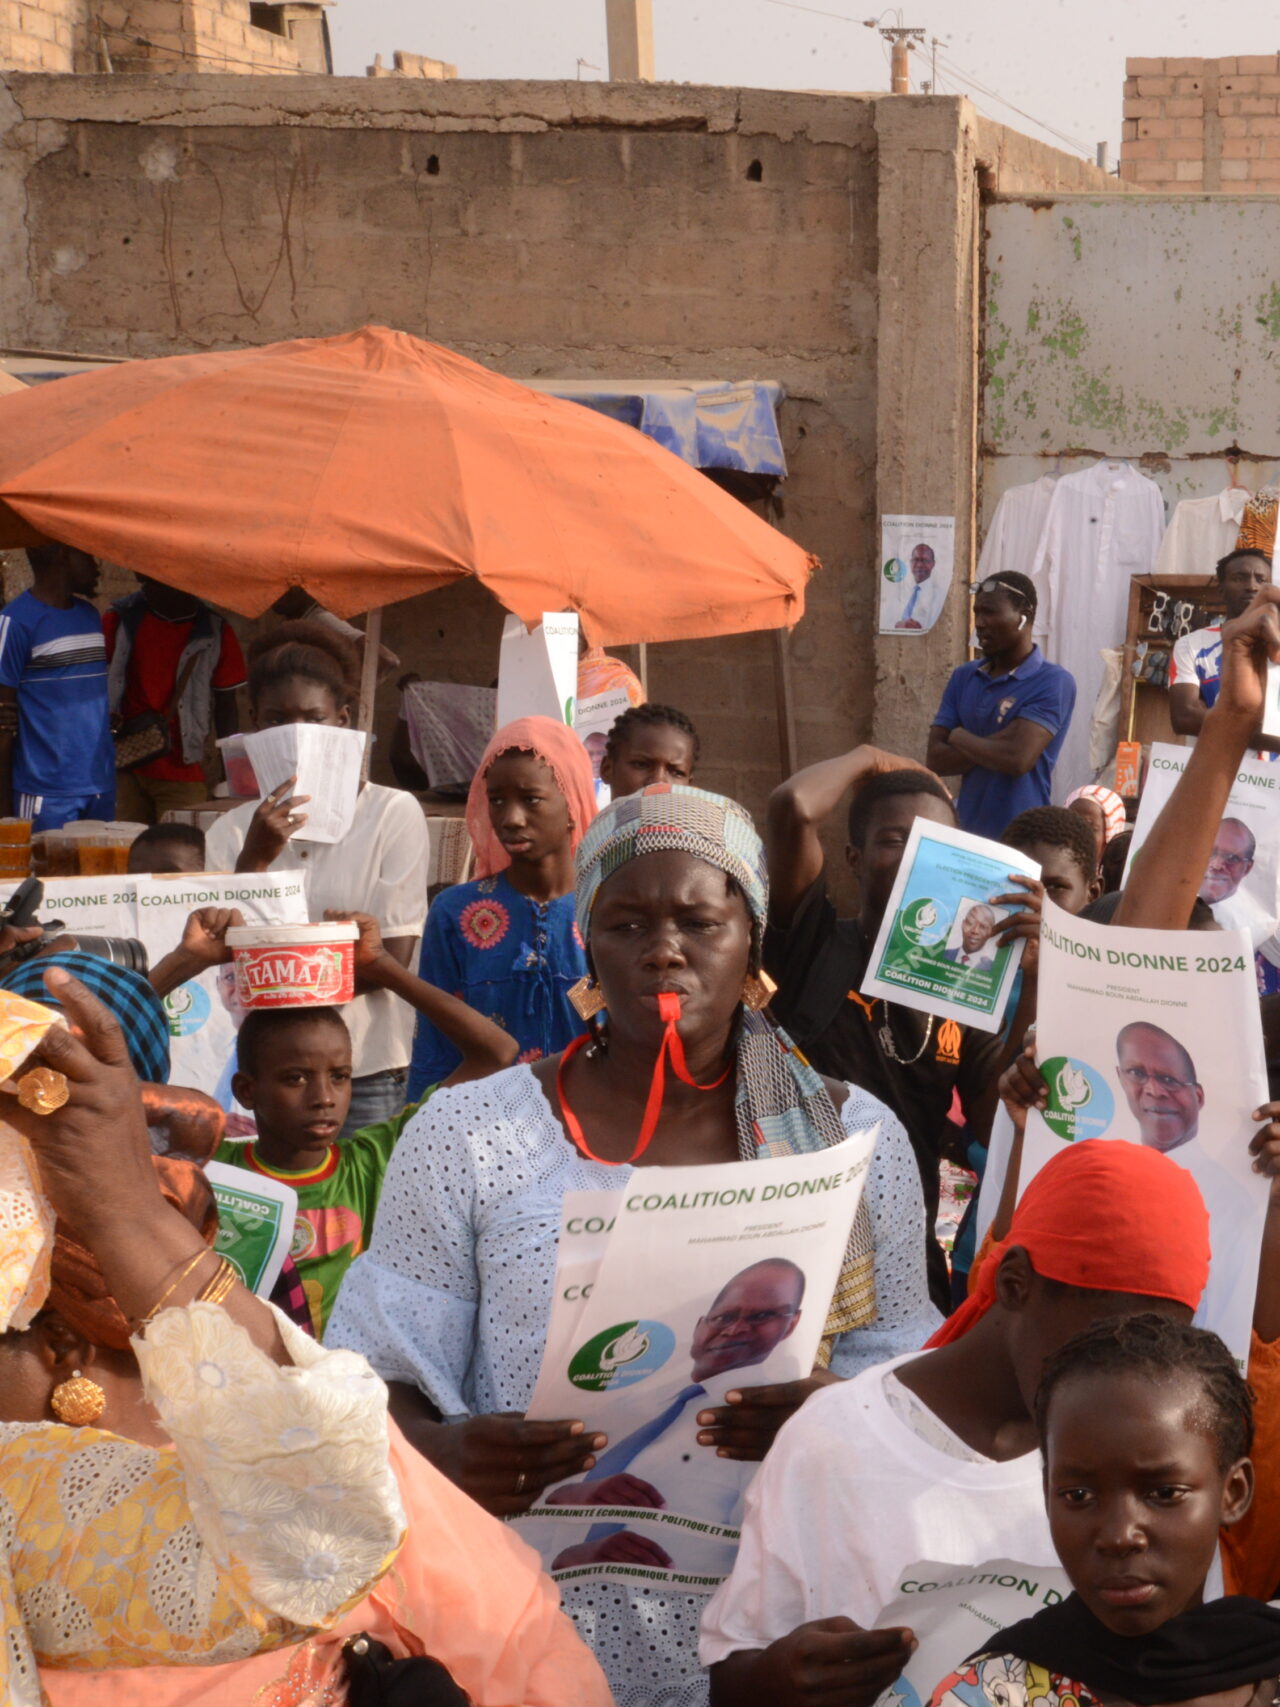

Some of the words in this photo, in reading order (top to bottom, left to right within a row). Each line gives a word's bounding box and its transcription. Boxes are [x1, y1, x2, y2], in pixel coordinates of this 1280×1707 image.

[577, 701, 608, 715] DIONNE
[1237, 773, 1276, 789] ONNE
[46, 894, 108, 909] DIONNE
[112, 892, 138, 904] 202
[141, 891, 220, 907] COALITION
[224, 887, 281, 900] DIONNE
[284, 885, 301, 897] 2024
[1106, 949, 1189, 972] DIONNE
[1196, 955, 1246, 973] 2024
[249, 959, 313, 986] TAMA
[885, 969, 931, 989] COALITION
[932, 981, 966, 1001] DIONNE
[967, 993, 988, 1007] 2024
[626, 1187, 756, 1212] COALITION
[762, 1172, 843, 1200] DIONNE
[660, 1514, 709, 1533] POLITIQUE
[709, 1525, 722, 1536] ET
[671, 1573, 720, 1586] POLITIQUE
[900, 1573, 1039, 1597] COALITION
